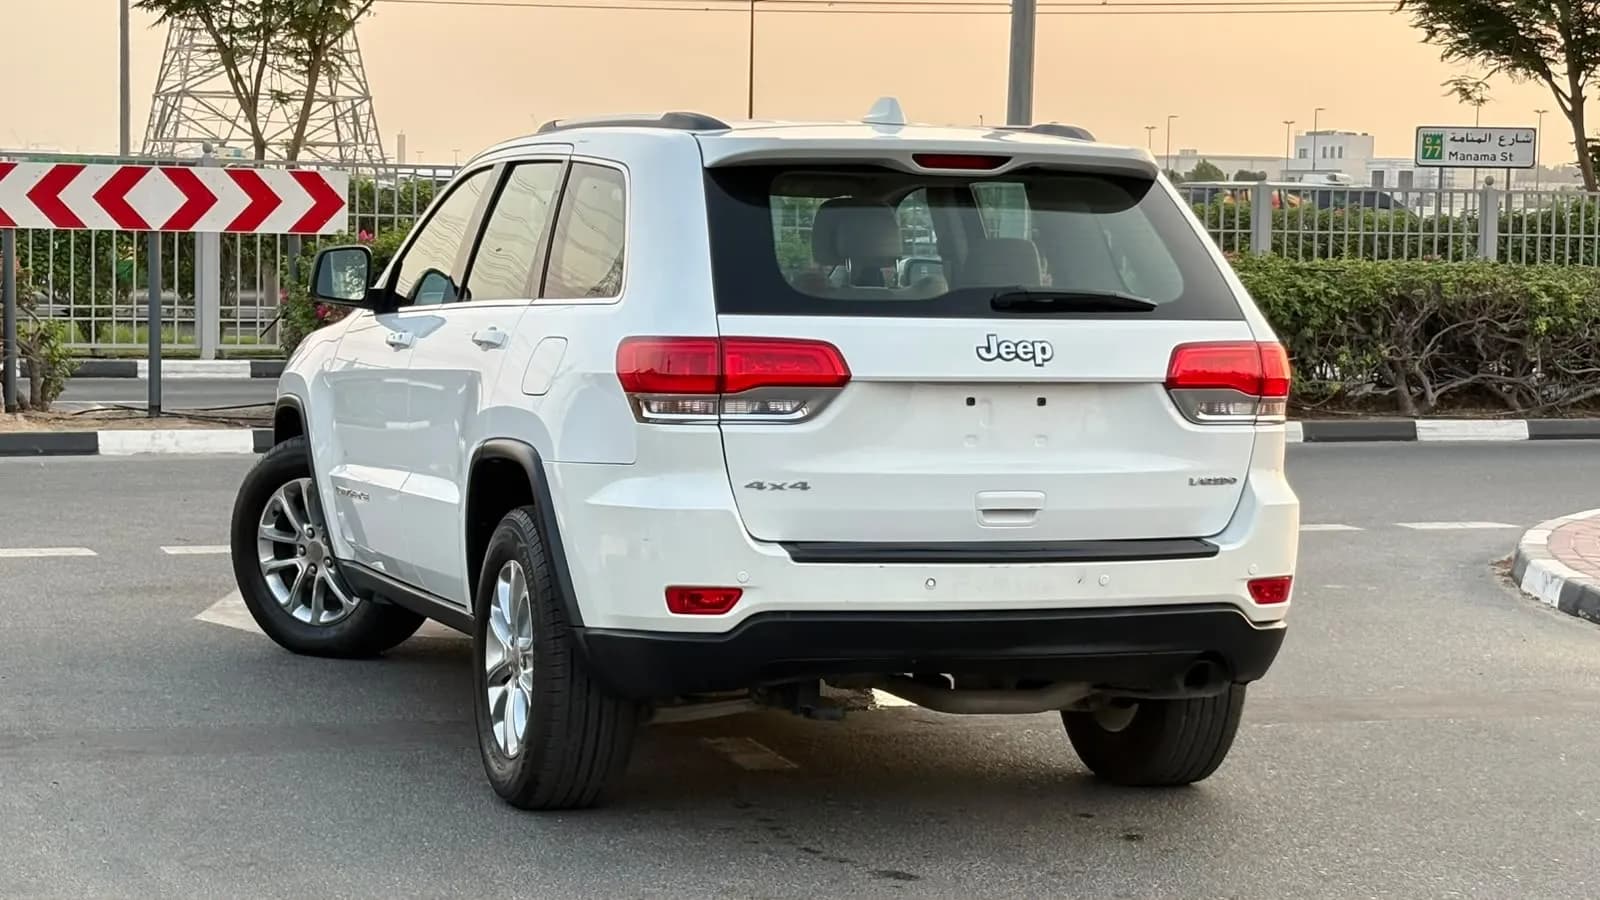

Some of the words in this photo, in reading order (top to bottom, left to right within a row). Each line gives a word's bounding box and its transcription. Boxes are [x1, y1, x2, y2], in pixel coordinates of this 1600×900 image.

[1449, 131, 1492, 144] المنامة
[1498, 132, 1532, 147] شارع
[1424, 145, 1441, 158] 77
[1448, 151, 1497, 162] Manama
[1500, 151, 1514, 162] St
[976, 333, 1054, 367] Jeep
